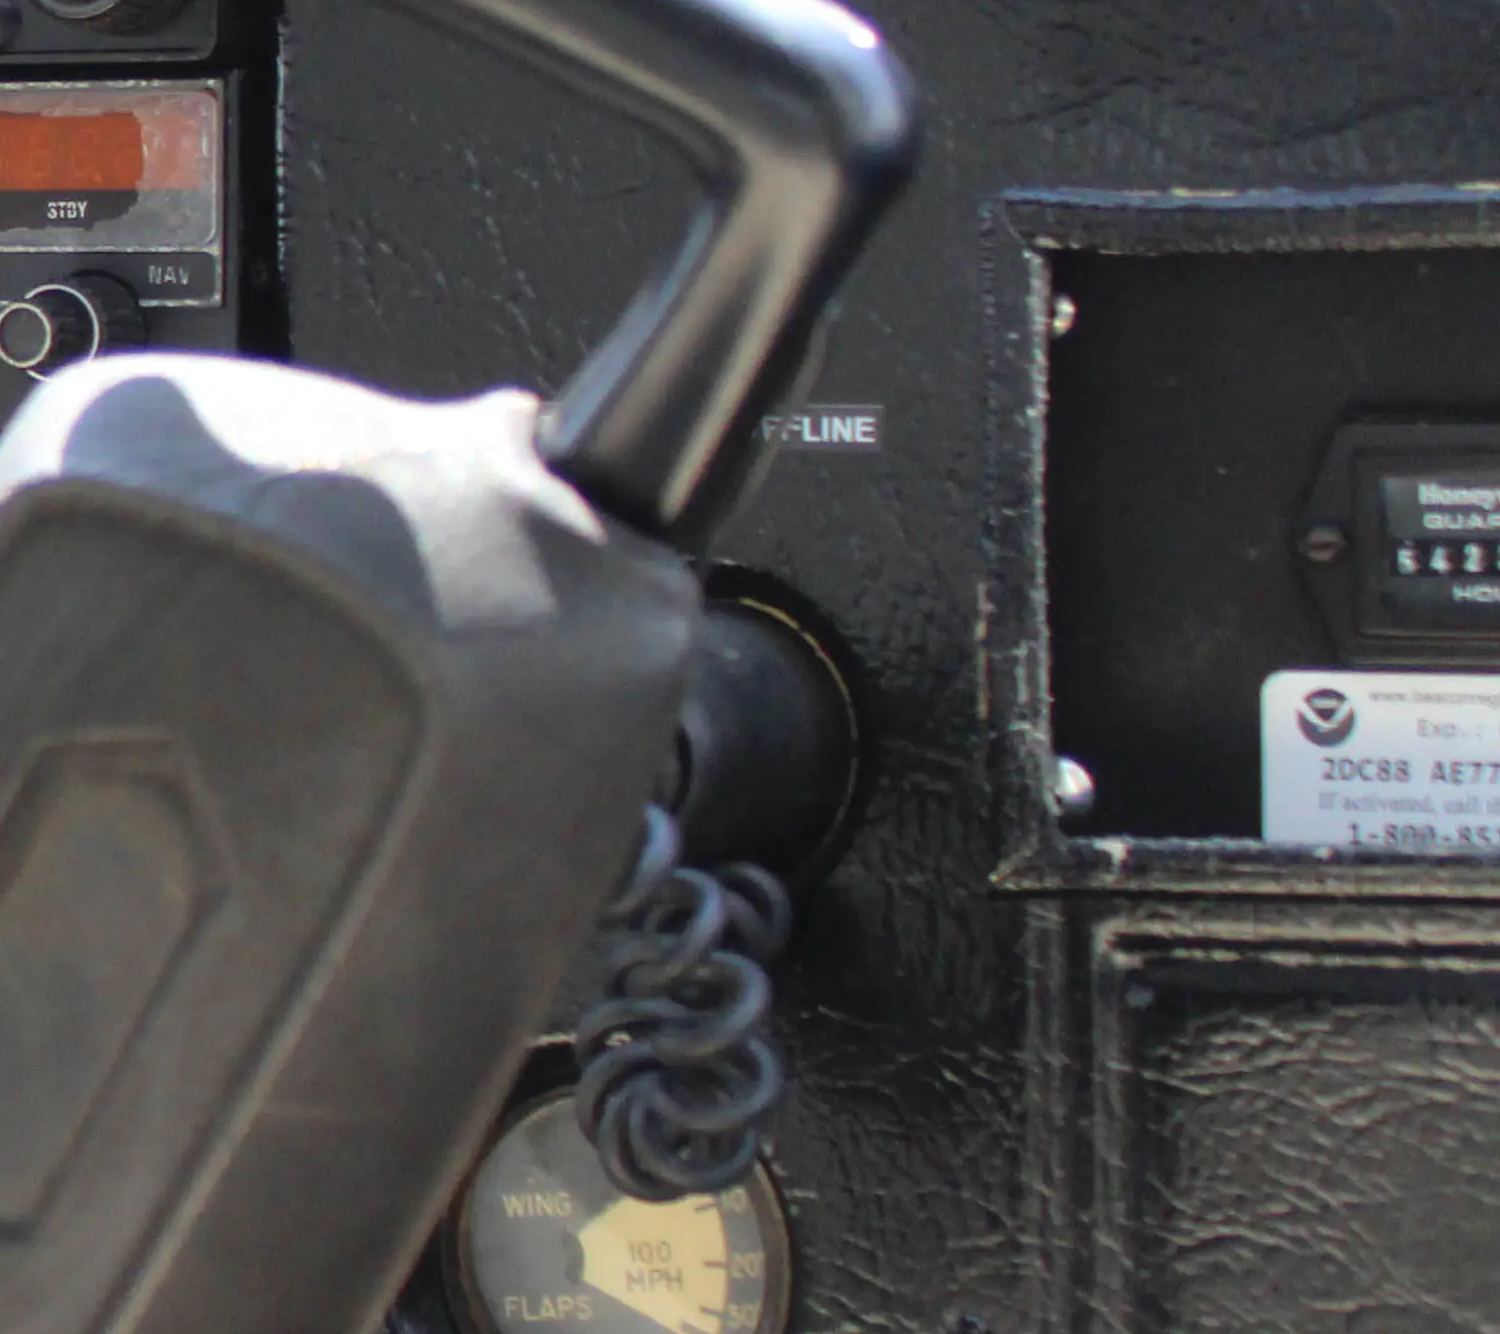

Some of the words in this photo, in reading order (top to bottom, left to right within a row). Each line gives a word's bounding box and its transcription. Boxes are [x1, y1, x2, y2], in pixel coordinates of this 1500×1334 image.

[148, 265, 190, 285] NAV
[502, 1192, 572, 1218] WING
[628, 1241, 672, 1264] 100
[625, 1269, 684, 1294] MPH
[504, 1296, 593, 1322] FLAPS
